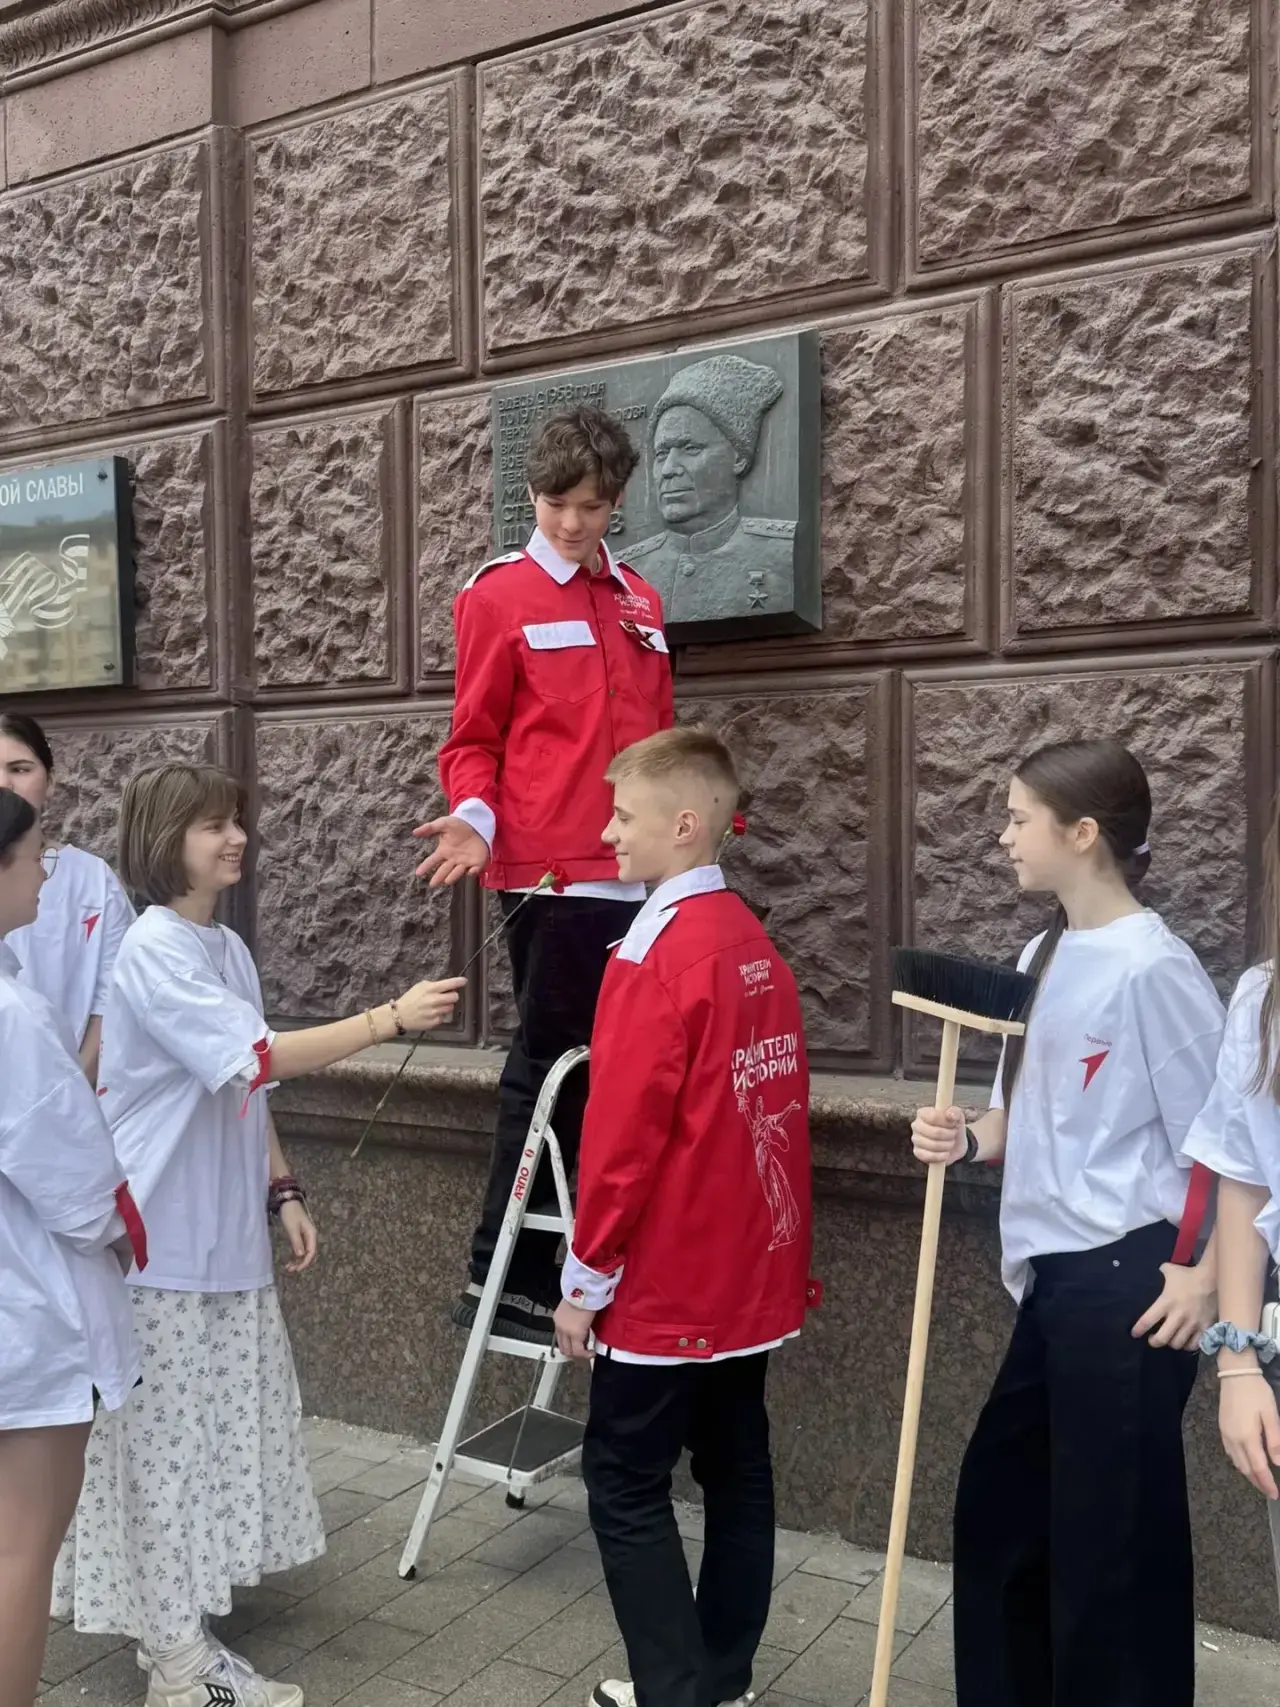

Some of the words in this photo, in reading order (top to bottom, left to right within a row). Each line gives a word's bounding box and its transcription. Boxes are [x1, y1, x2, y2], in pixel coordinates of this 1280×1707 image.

[498, 393, 534, 411] ЗДЕСЬ
[575, 381, 606, 400] ГОДА
[500, 411, 514, 426] ПО
[0, 478, 21, 507] ОЙ
[26, 472, 84, 503] СЛАВЫ
[733, 1053, 798, 1092] ИСТОРИИ
